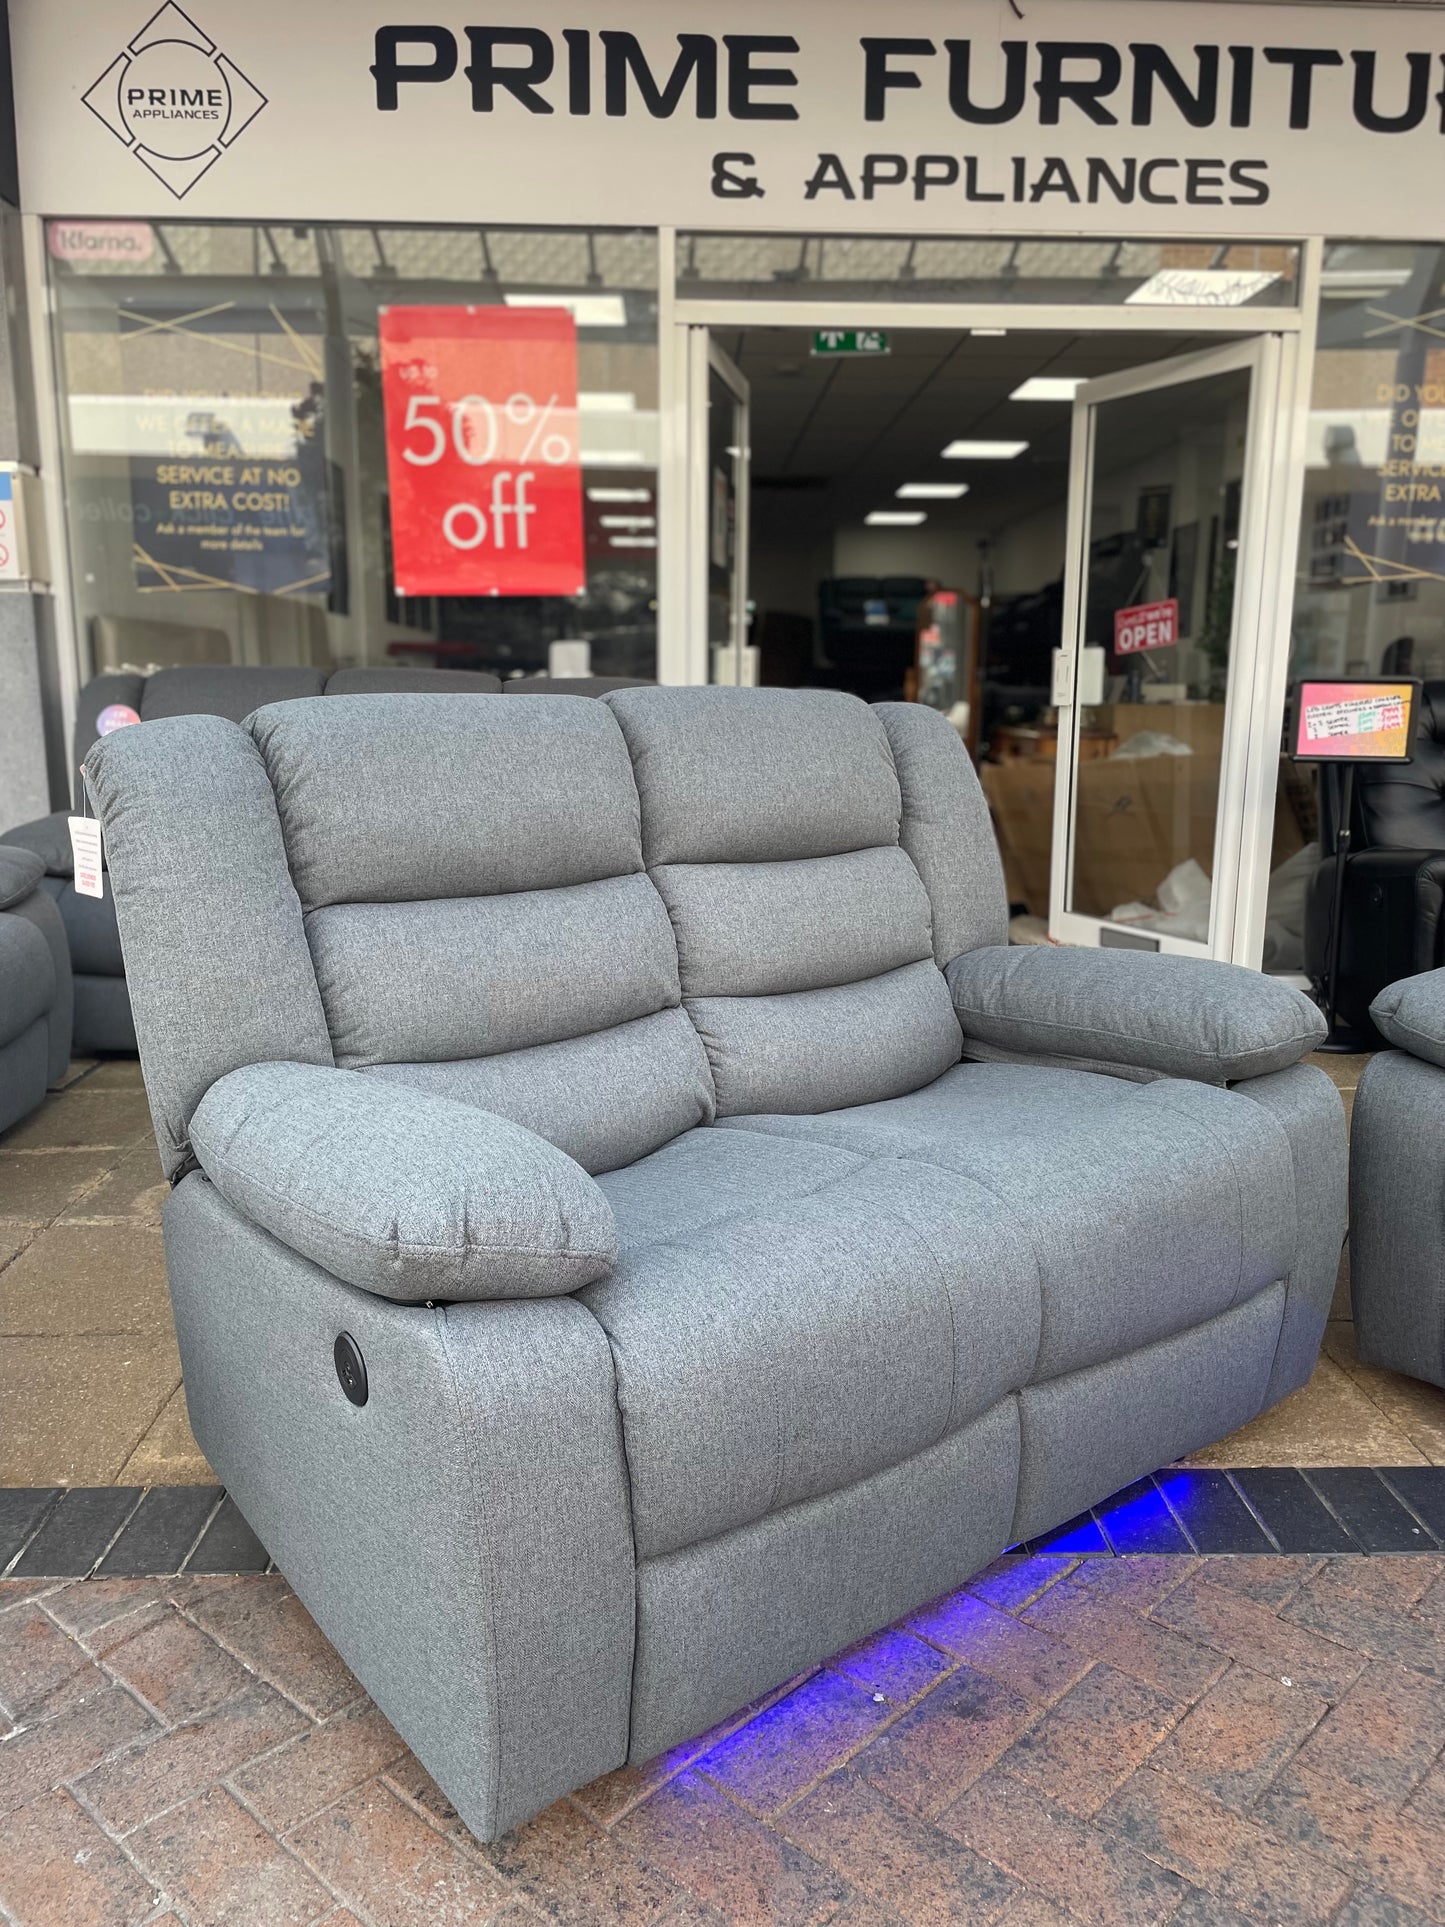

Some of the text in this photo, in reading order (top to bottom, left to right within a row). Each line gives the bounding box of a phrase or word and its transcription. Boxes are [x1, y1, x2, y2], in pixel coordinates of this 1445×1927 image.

[369, 24, 1445, 135] PRIME FURNITU
[127, 88, 223, 107] PRIME
[133, 109, 219, 120] APPLIANCES
[710, 151, 1270, 206] & APPLIANCES
[402, 391, 571, 467] 50%
[156, 464, 302, 488] SERVICE AT NO
[168, 490, 291, 513] EXTRA COST!
[1384, 483, 1442, 502] EXTRA
[442, 471, 537, 550] off
[1119, 619, 1173, 651] OPEN
